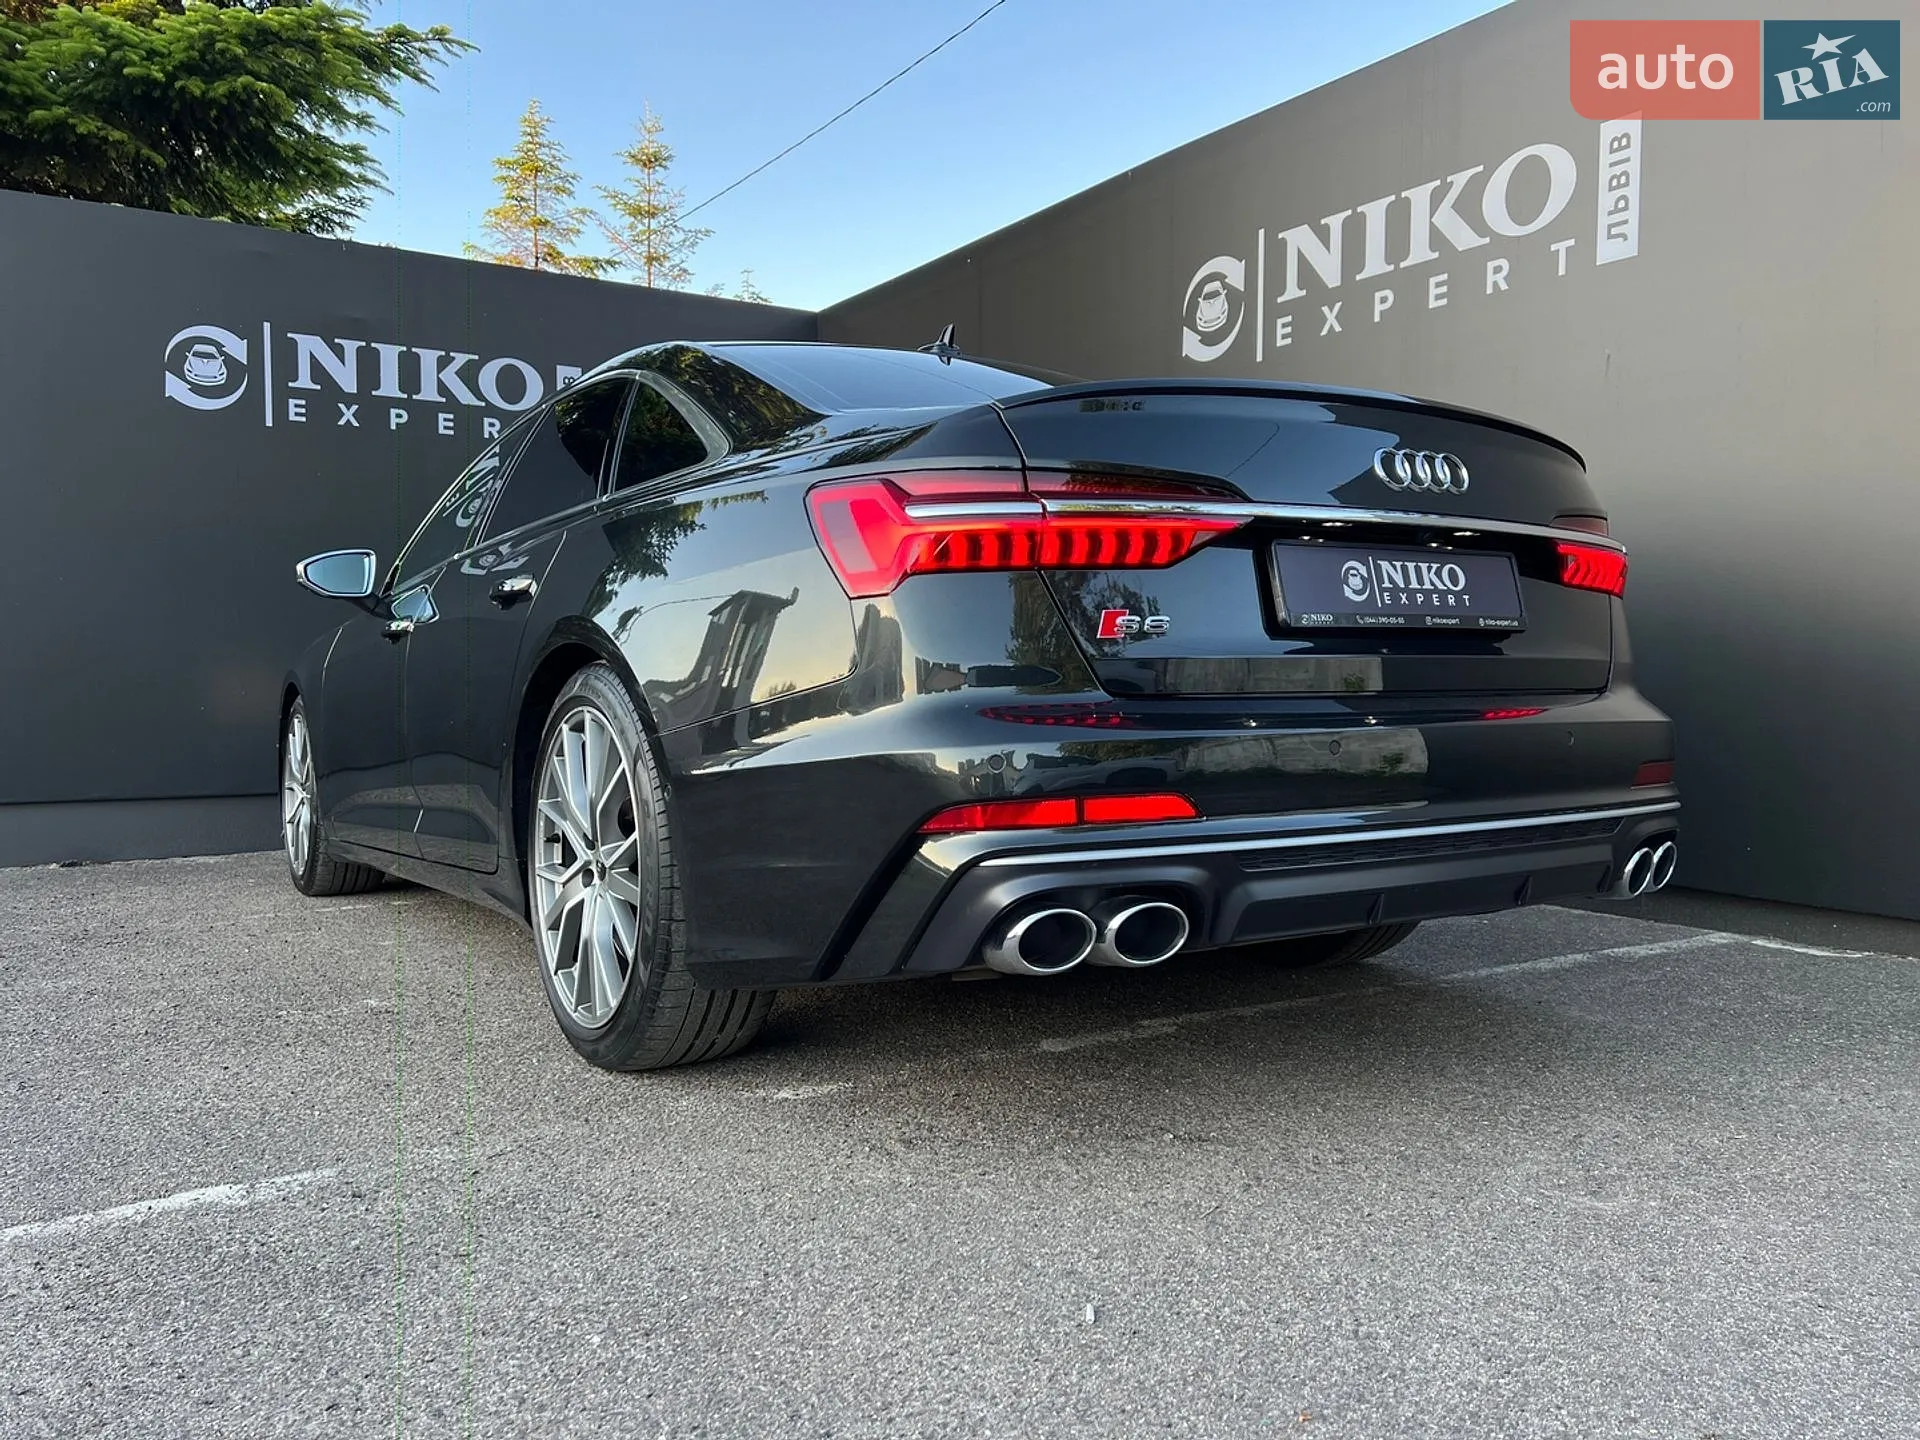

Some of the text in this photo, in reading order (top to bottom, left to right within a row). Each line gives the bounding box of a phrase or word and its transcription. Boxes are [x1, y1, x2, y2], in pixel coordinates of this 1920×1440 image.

[1606, 131, 1632, 242] ЛЬВІВ
[1277, 143, 1578, 303] NIKO
[1276, 238, 1576, 347] EXPERT
[287, 332, 544, 411] NIKO
[288, 398, 501, 439] EXPER
[1377, 560, 1467, 591] NIKO
[1383, 592, 1471, 607] EXPERT
[1113, 615, 1171, 633] S6
